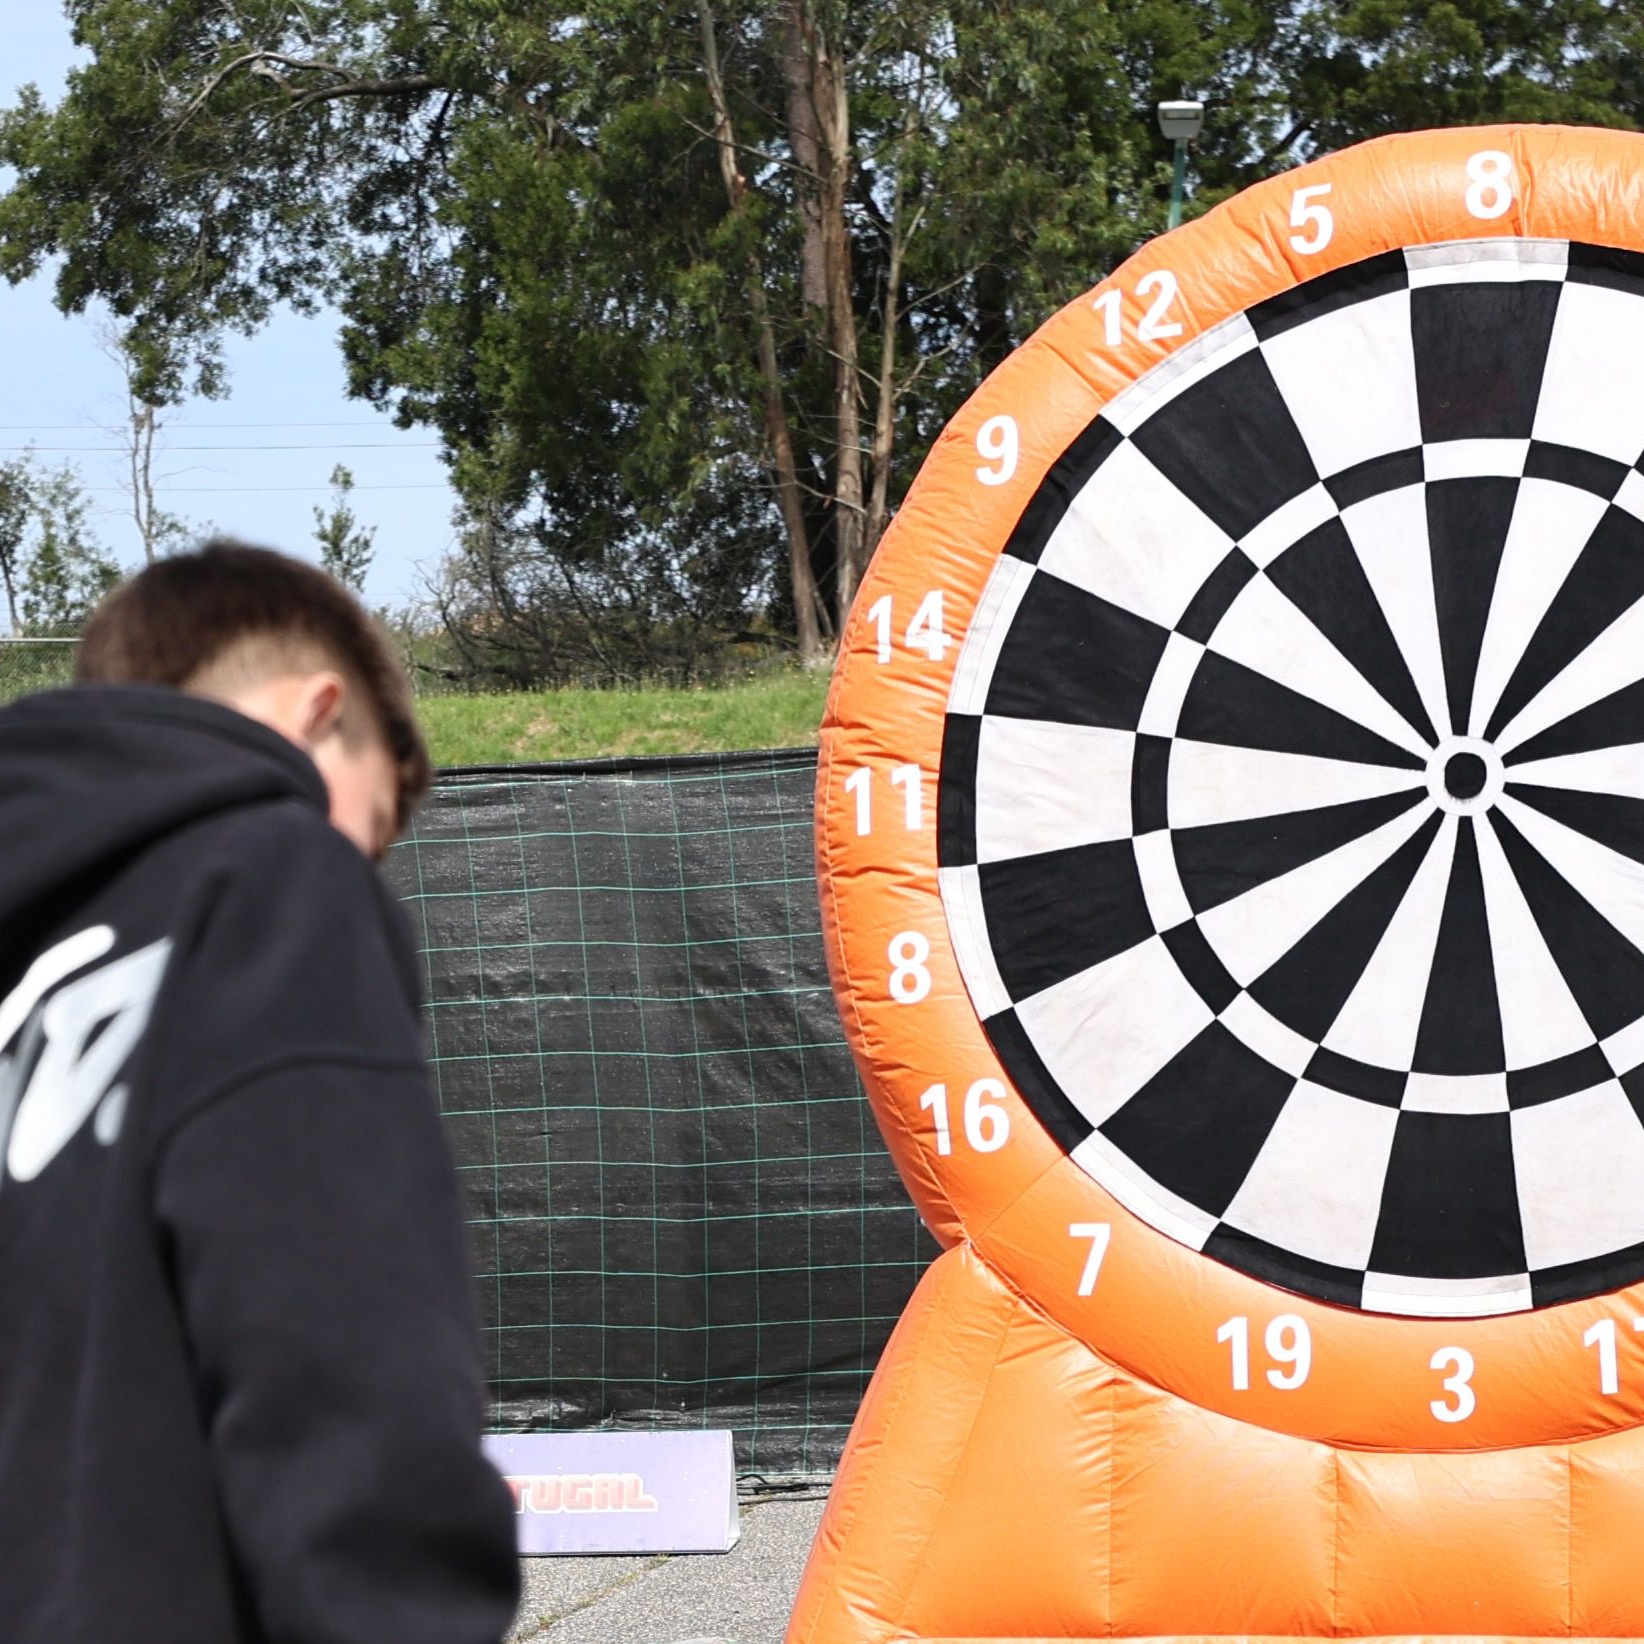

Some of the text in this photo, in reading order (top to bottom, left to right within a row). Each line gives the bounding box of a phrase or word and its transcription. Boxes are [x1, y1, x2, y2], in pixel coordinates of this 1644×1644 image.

[1289, 183, 1334, 254] 5
[1465, 150, 1513, 219] 8
[1092, 270, 1183, 346] 12
[975, 415, 1020, 486] 9
[867, 590, 953, 664] 14
[844, 763, 923, 837] 11
[887, 931, 932, 1004] 8
[919, 1077, 1011, 1156] 16
[1068, 1222, 1111, 1297] 7
[1216, 1313, 1313, 1391] 19
[1428, 1346, 1476, 1423] 3
